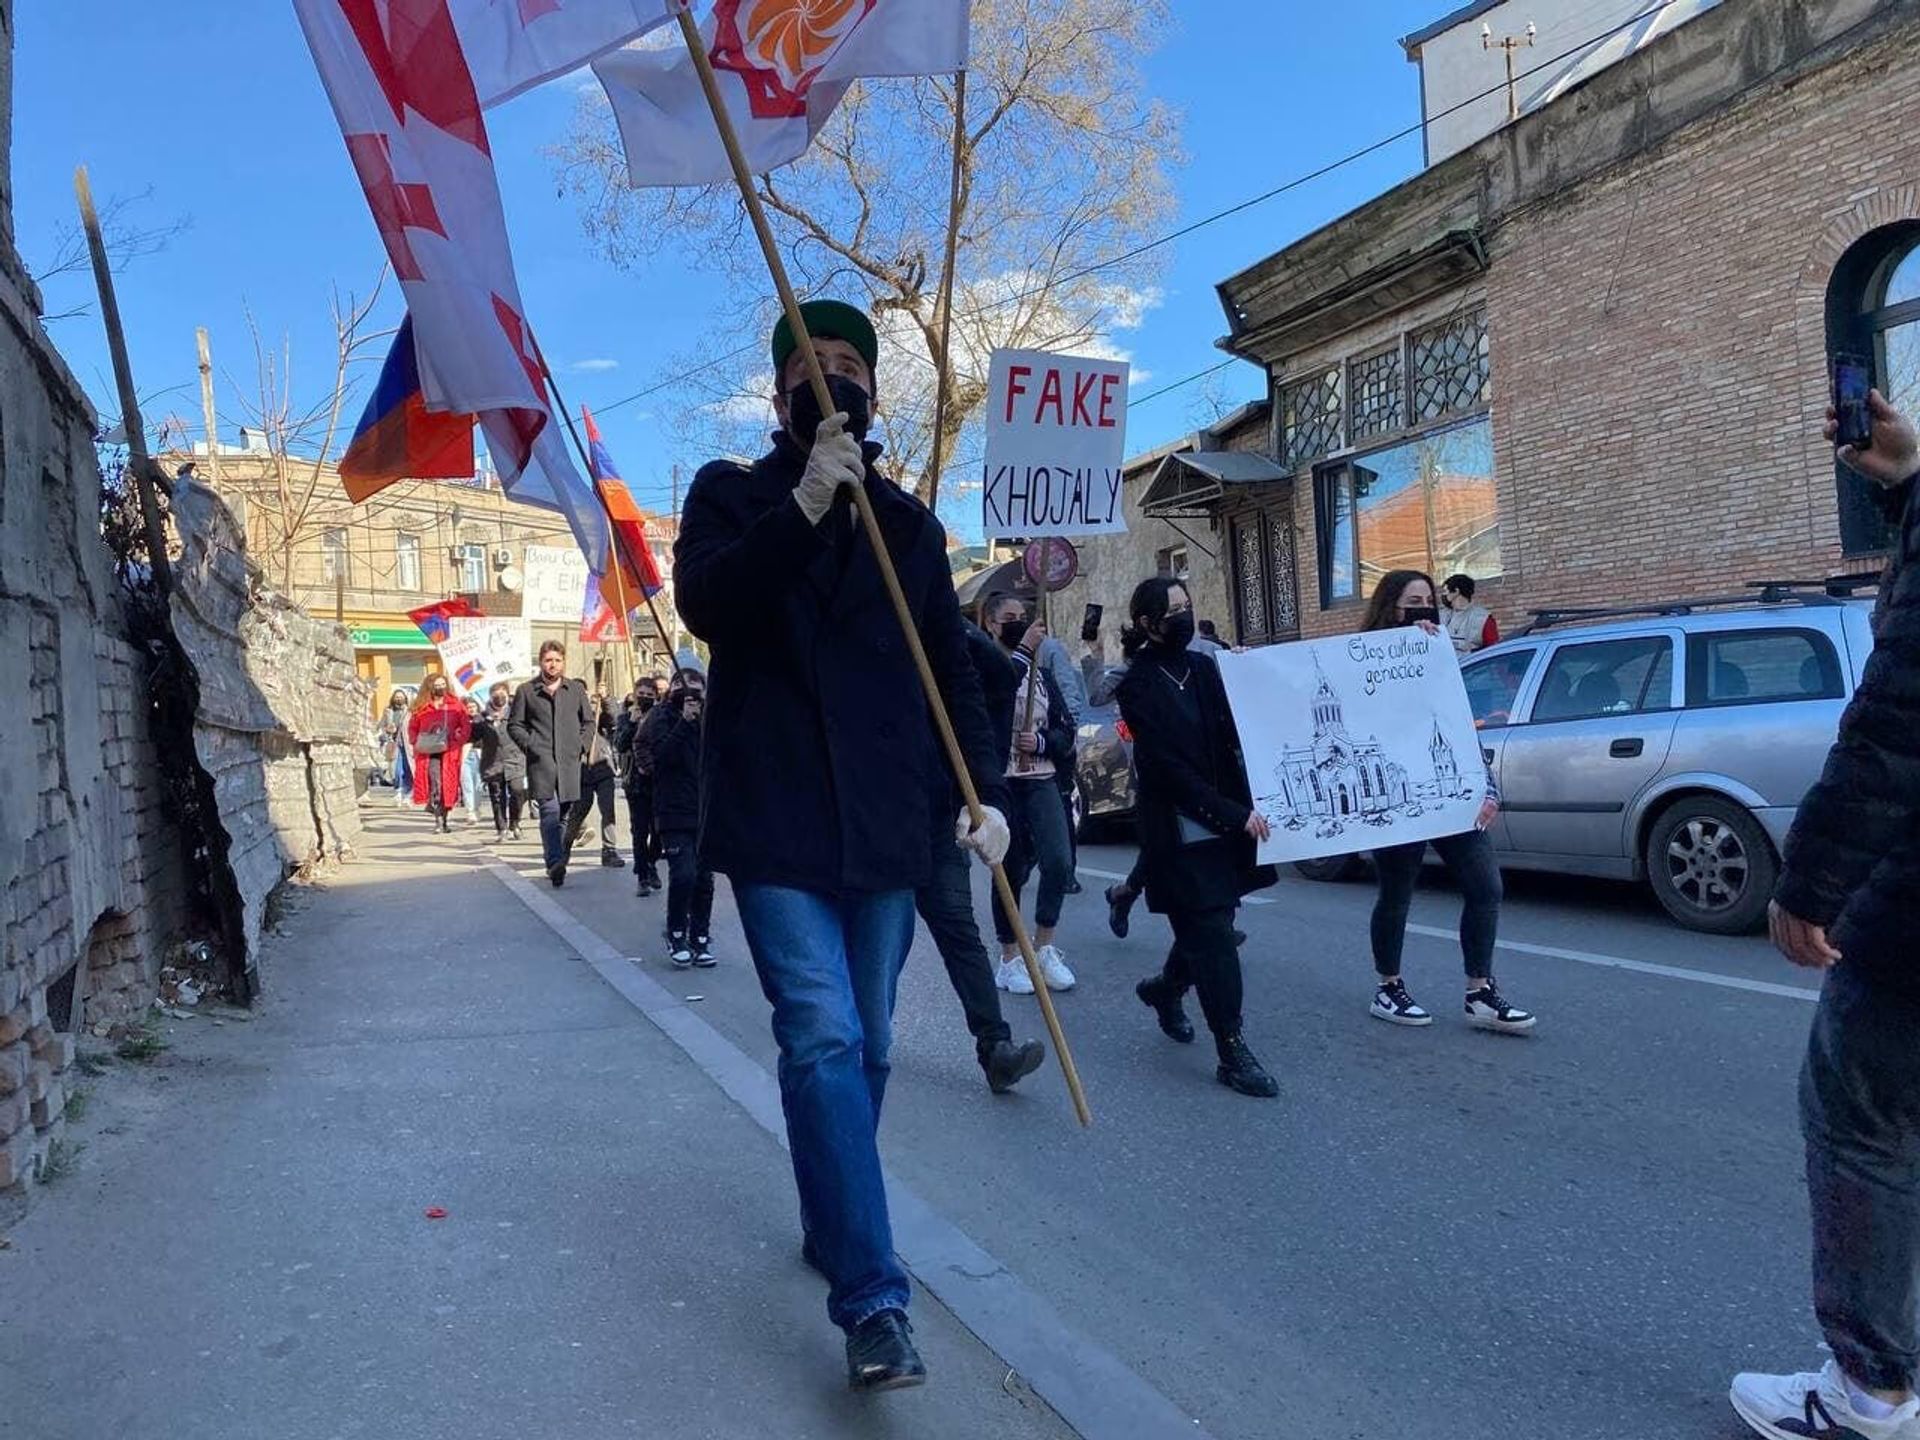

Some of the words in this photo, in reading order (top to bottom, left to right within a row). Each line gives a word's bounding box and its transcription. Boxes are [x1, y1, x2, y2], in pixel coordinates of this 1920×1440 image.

[1006, 366, 1120, 427] FAKE
[983, 465, 1121, 526] KHOJALY
[1364, 659, 1424, 695] genocide
